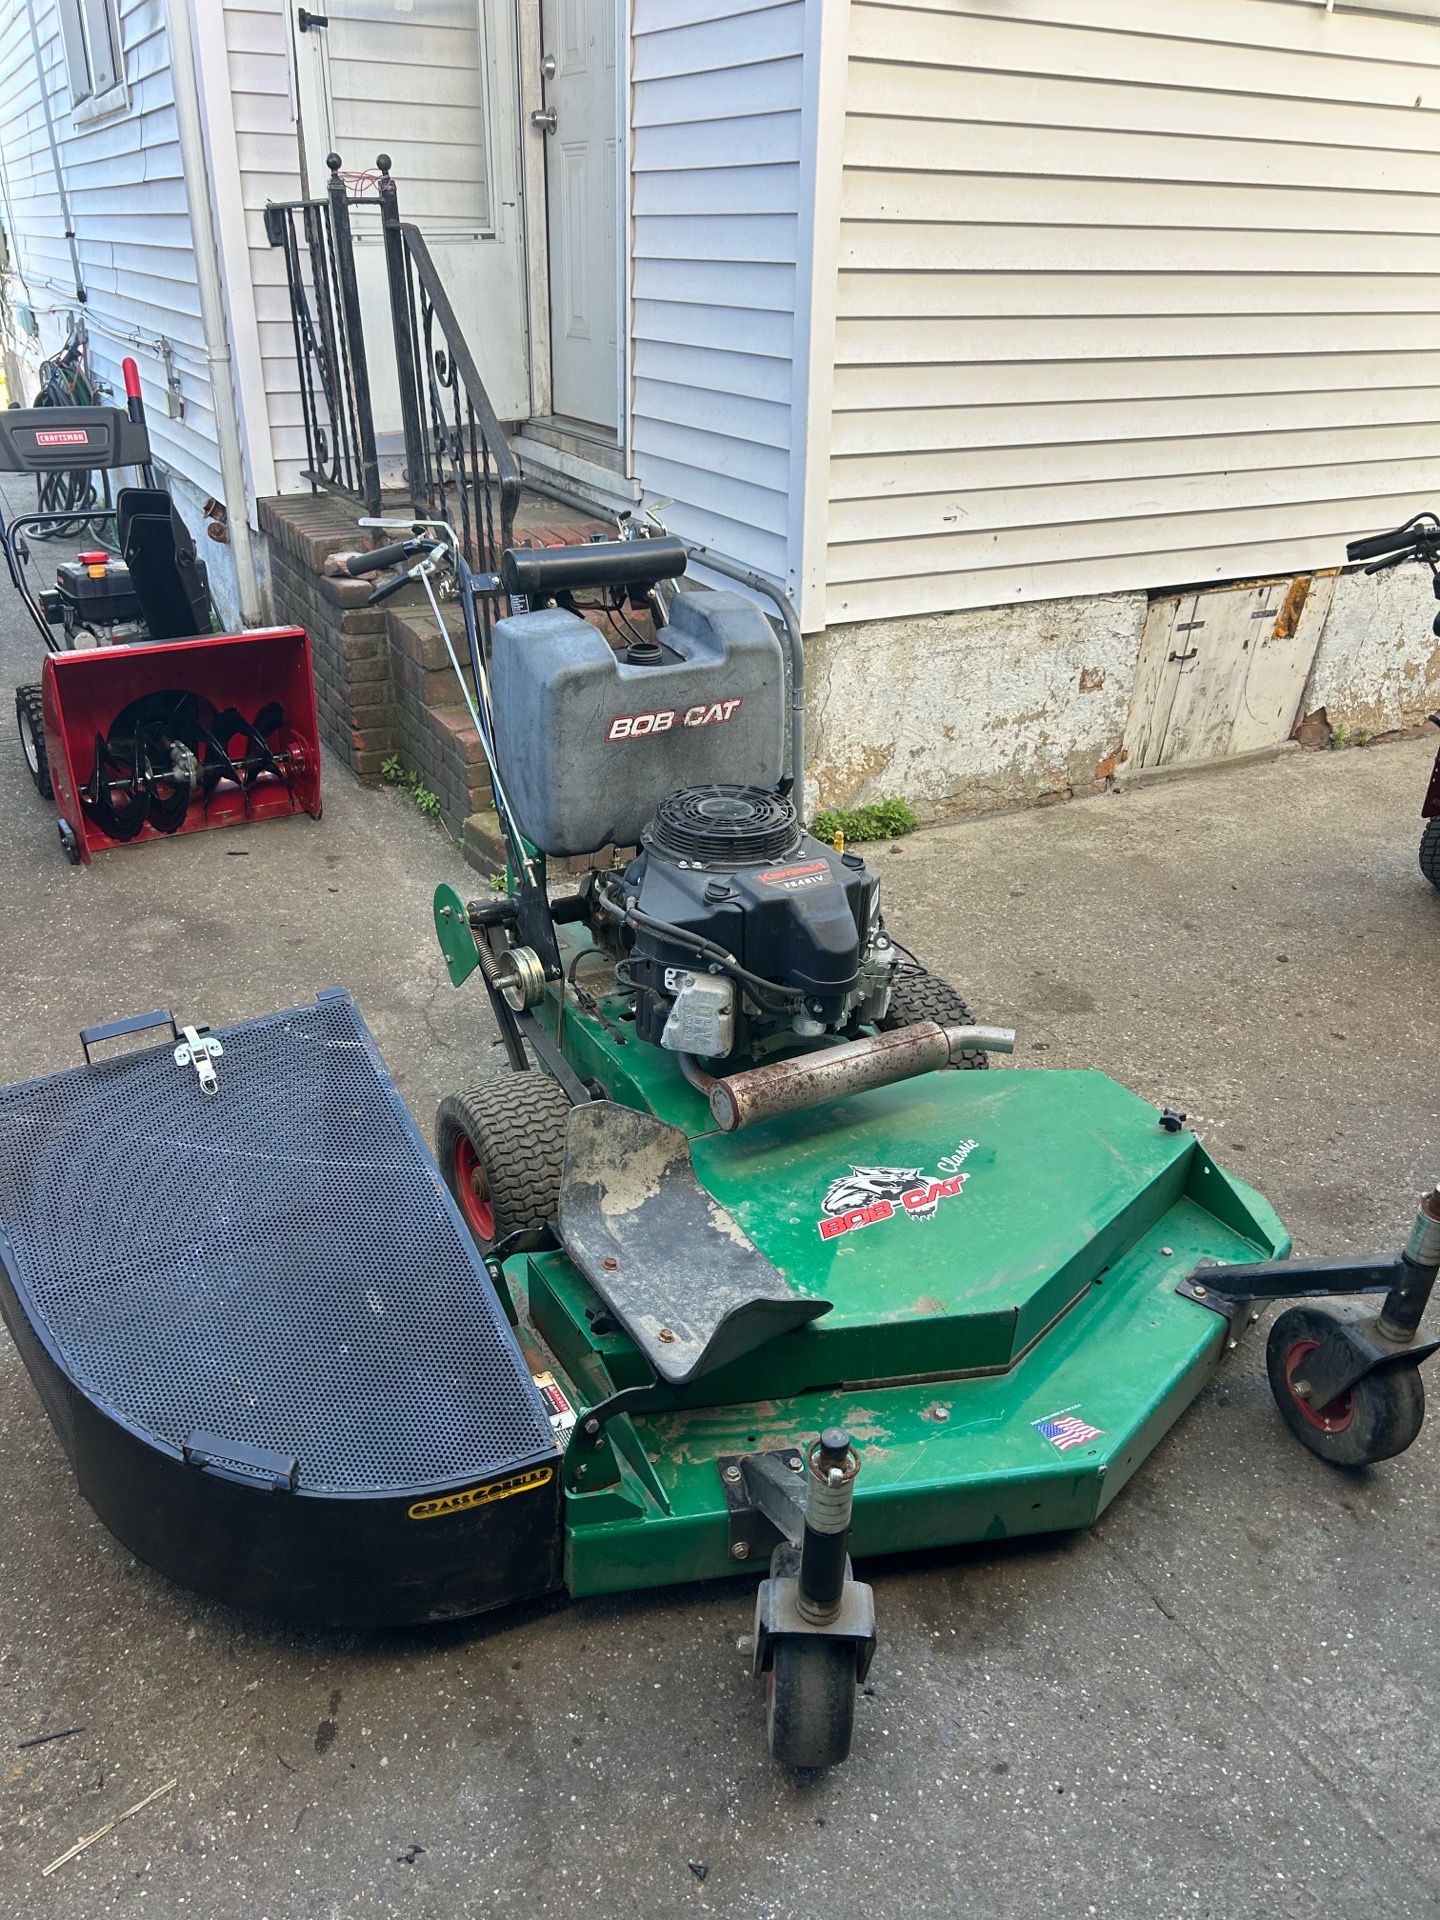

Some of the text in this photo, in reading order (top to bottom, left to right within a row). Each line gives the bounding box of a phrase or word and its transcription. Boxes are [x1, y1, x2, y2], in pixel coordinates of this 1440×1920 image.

[38, 432, 86, 444] CRAFTSMAN
[936, 1137, 980, 1173] Classic
[412, 1468, 550, 1517] GRASS GOBBLER
